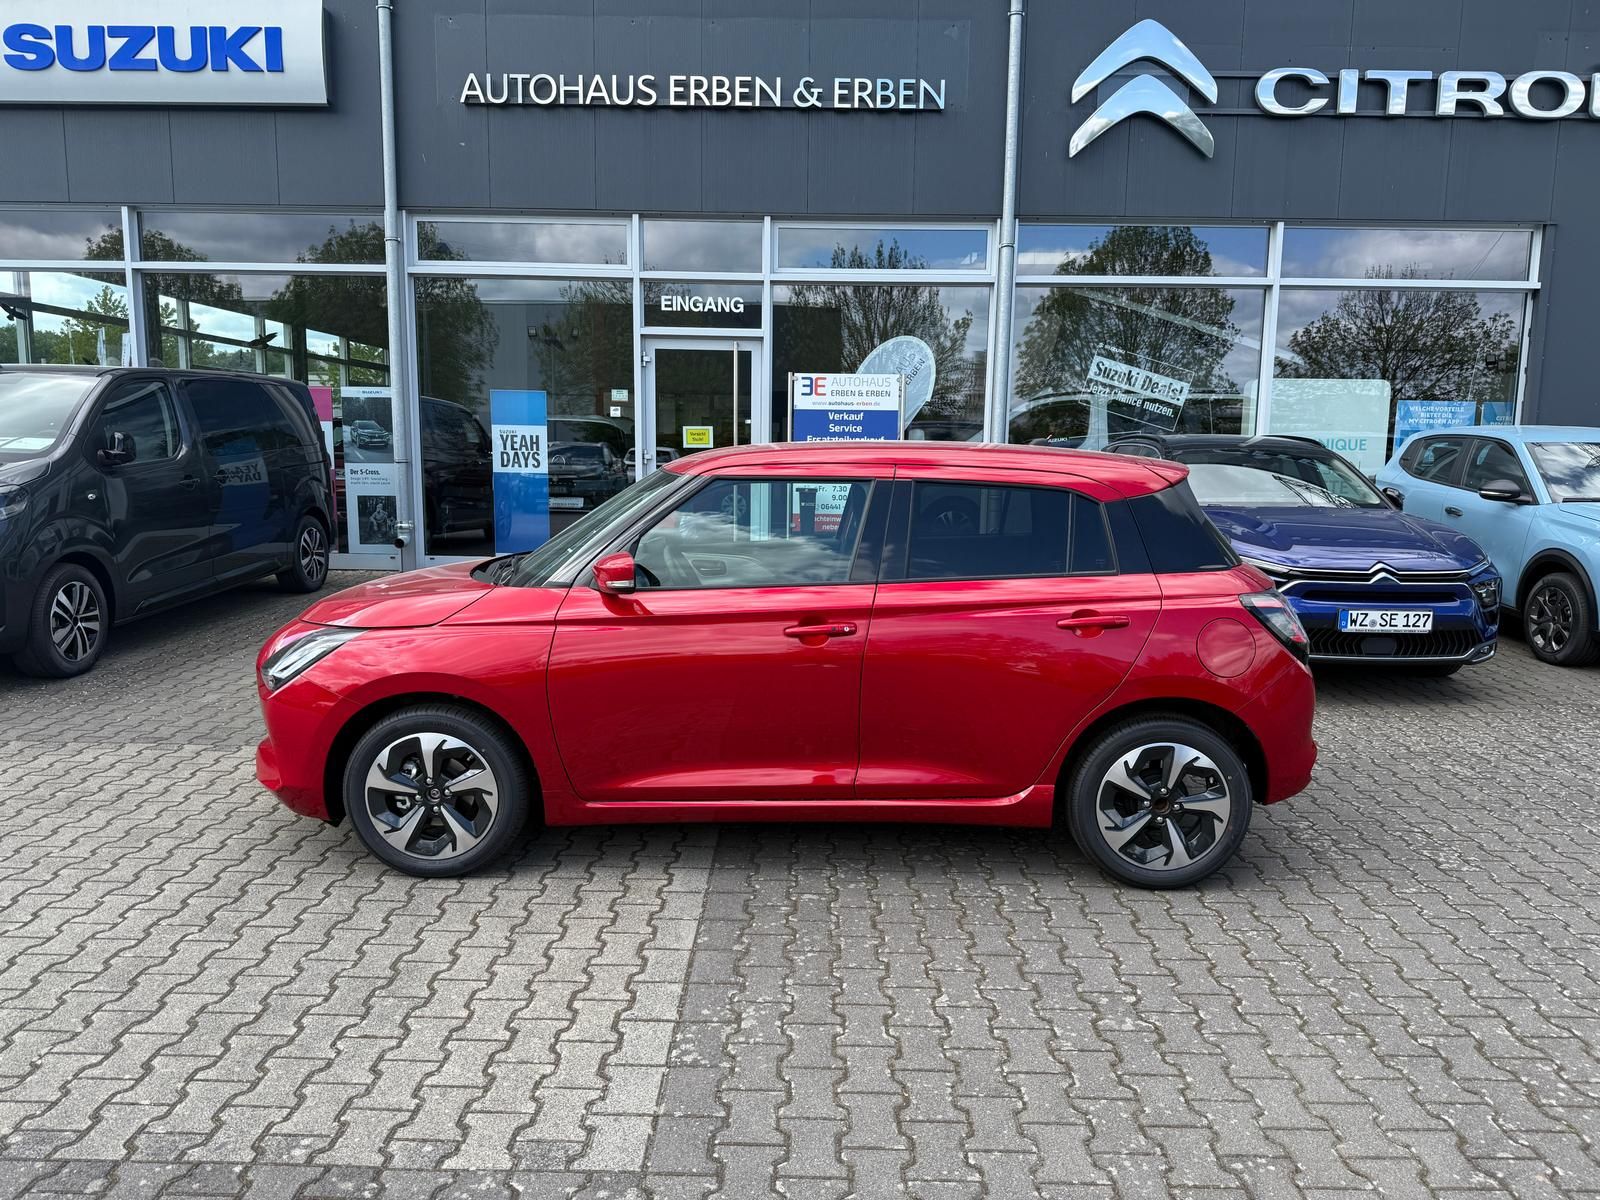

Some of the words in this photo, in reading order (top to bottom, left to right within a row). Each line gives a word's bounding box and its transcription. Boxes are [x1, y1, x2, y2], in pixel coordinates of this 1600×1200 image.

[3, 23, 285, 73] SUZUKI
[460, 73, 657, 106] AUTOHAUS
[669, 75, 781, 107] ERBEN
[793, 76, 823, 108] &
[834, 78, 946, 109] ERBEN
[1255, 67, 1600, 119] CITRO
[661, 295, 744, 313] EINGANG
[831, 377, 891, 388] AUTOHAUS
[1094, 361, 1140, 387] Suzuki
[1141, 375, 1184, 401] Deals!
[1111, 389, 1142, 407] Chance
[1143, 401, 1175, 417] nutzen.
[828, 412, 864, 421] Verkauf
[829, 423, 863, 433] Service
[500, 434, 540, 451] YEAH
[1321, 438, 1367, 451] NIQUE
[500, 451, 541, 468] DAYS
[1350, 612, 1368, 627] WZ
[1379, 613, 1399, 627] SE
[1402, 613, 1431, 628] 127
